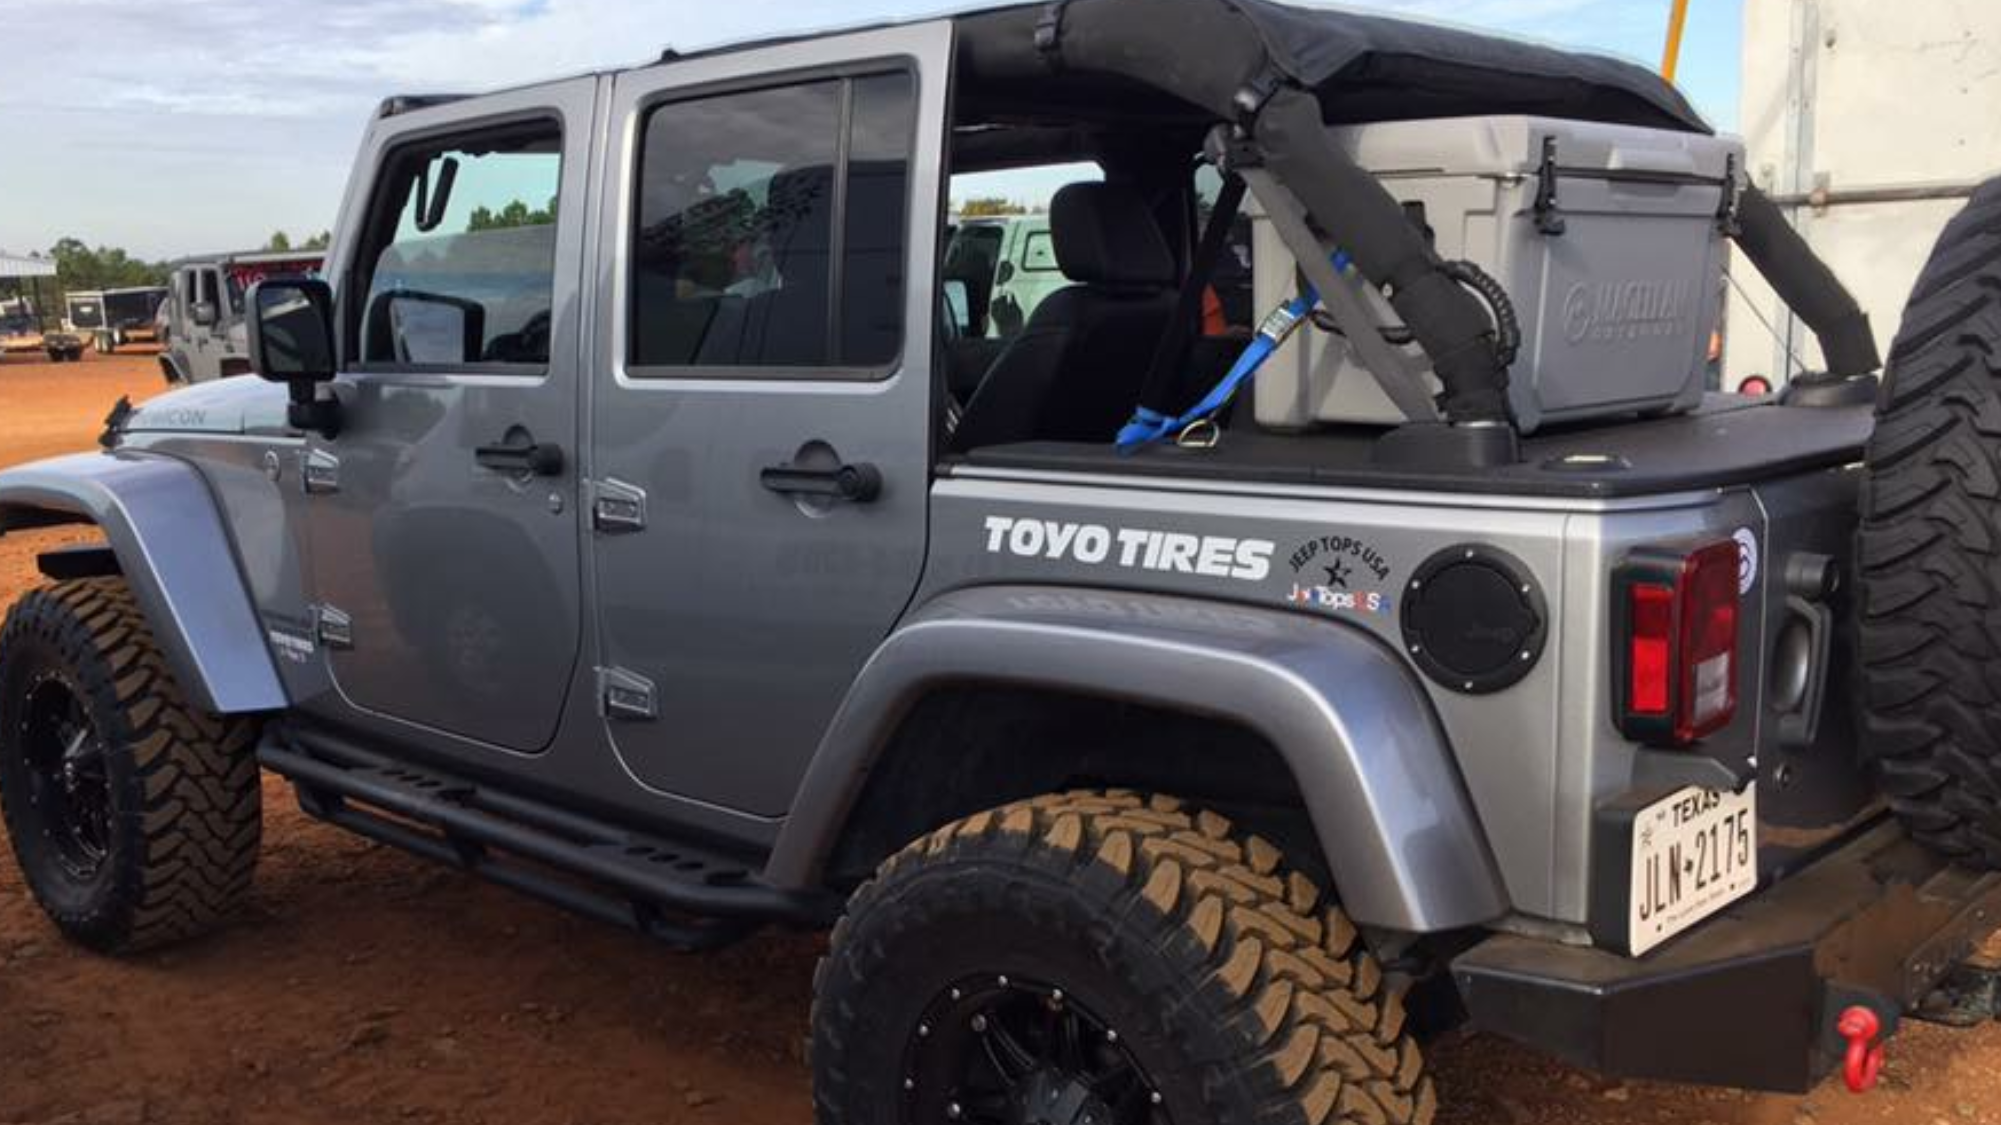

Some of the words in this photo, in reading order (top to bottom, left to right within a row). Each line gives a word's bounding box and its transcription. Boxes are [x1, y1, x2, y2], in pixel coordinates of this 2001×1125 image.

[984, 516, 1111, 563] TOYO
[1117, 528, 1275, 581] TIRES
[1289, 540, 1318, 573] JEEP
[1320, 536, 1362, 556] TOPS
[1362, 547, 1391, 580] USA
[1672, 790, 1721, 828] TEXAS
